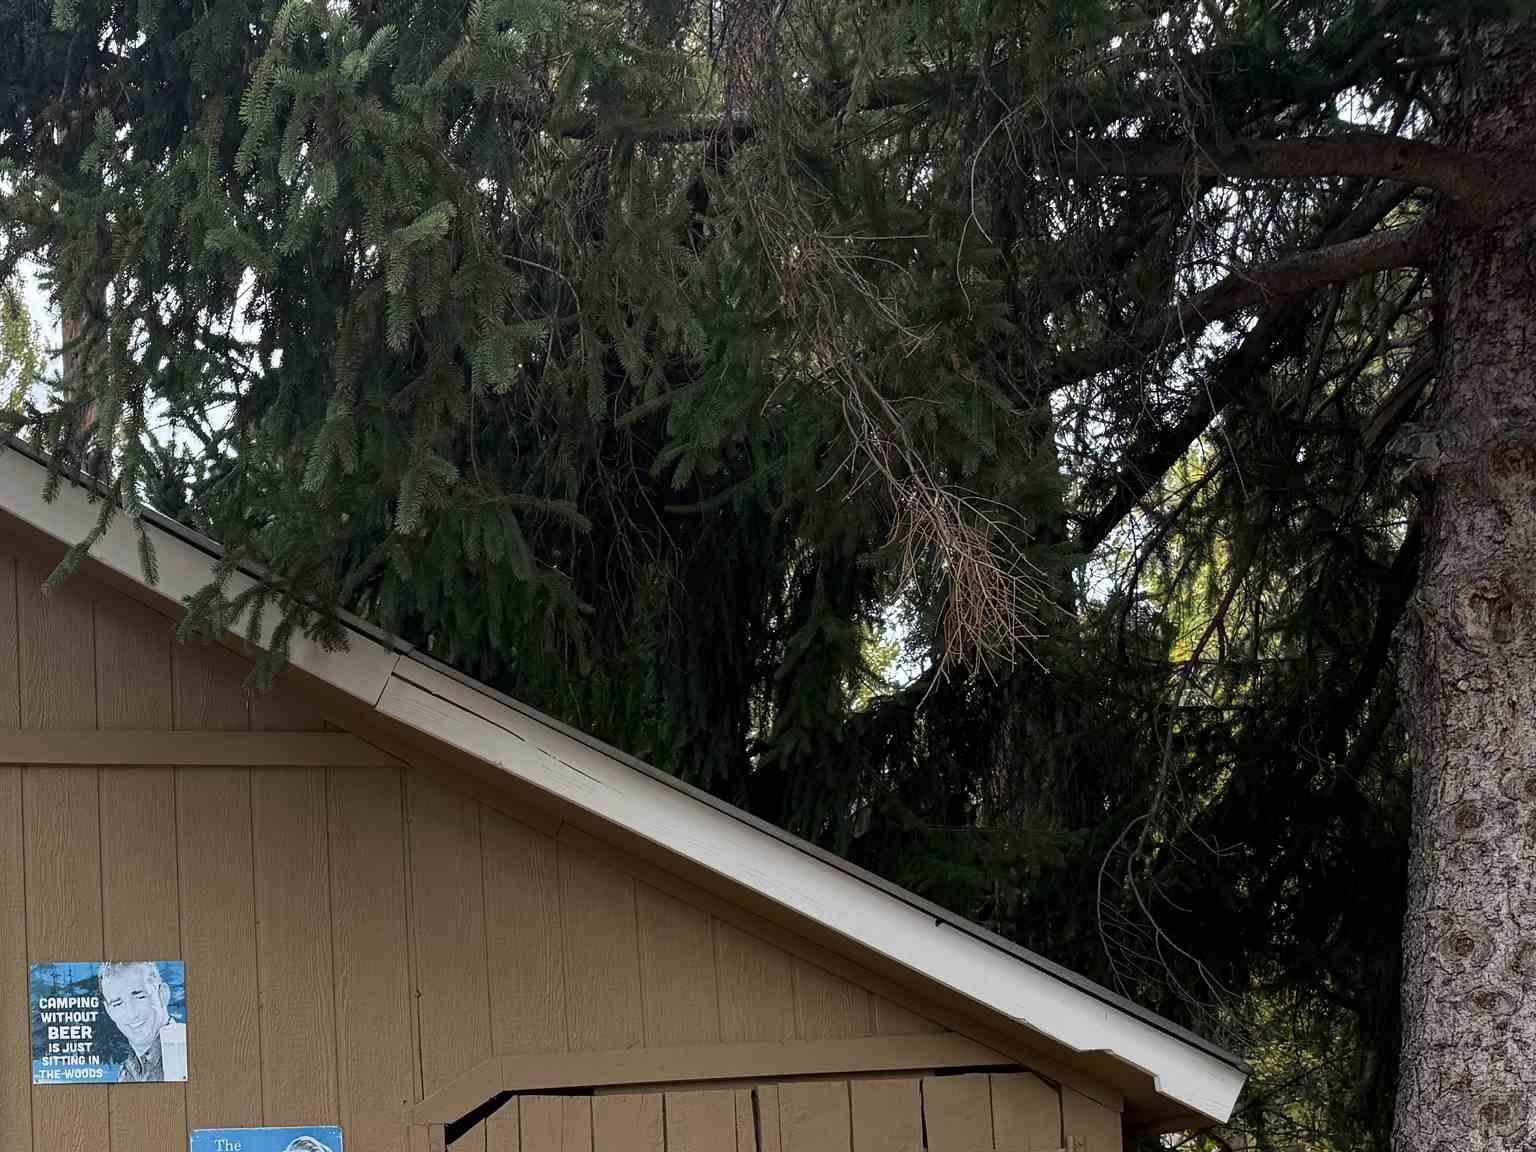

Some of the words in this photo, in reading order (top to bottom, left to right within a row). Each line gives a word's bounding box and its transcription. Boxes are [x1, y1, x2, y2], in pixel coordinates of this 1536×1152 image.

[39, 997, 100, 1009] CAMPING
[40, 1011, 99, 1023] WITHOUT
[47, 1025, 93, 1040] BEER
[48, 1043, 61, 1053] IS
[62, 1042, 93, 1053] JUST
[42, 1056, 86, 1066] SITTING
[88, 1055, 100, 1065] IN
[39, 1069, 61, 1080] THE
[64, 1068, 104, 1079] WOODS
[214, 1139, 241, 1151] The
